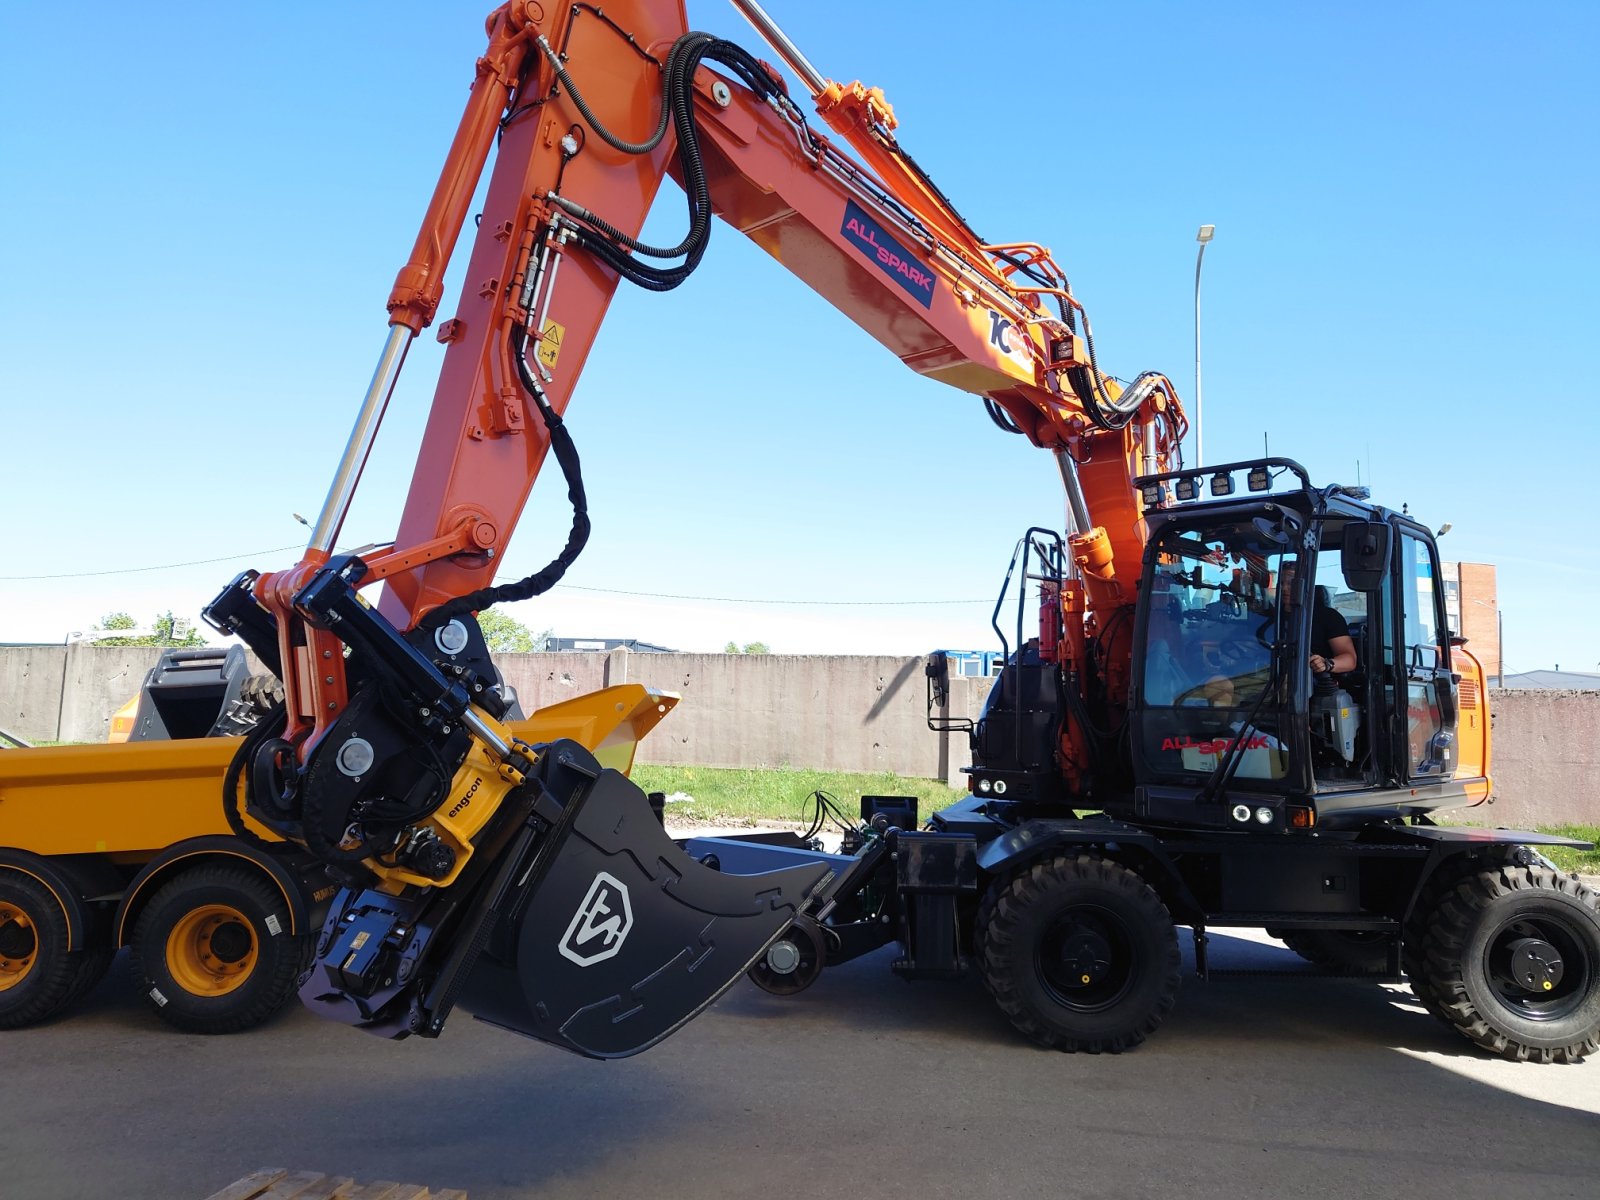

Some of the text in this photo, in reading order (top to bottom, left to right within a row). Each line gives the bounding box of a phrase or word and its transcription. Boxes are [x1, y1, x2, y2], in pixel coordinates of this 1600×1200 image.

[846, 217, 932, 291] ALL SPARK
[1162, 736, 1199, 751] ALL
[448, 777, 483, 818] engcon
